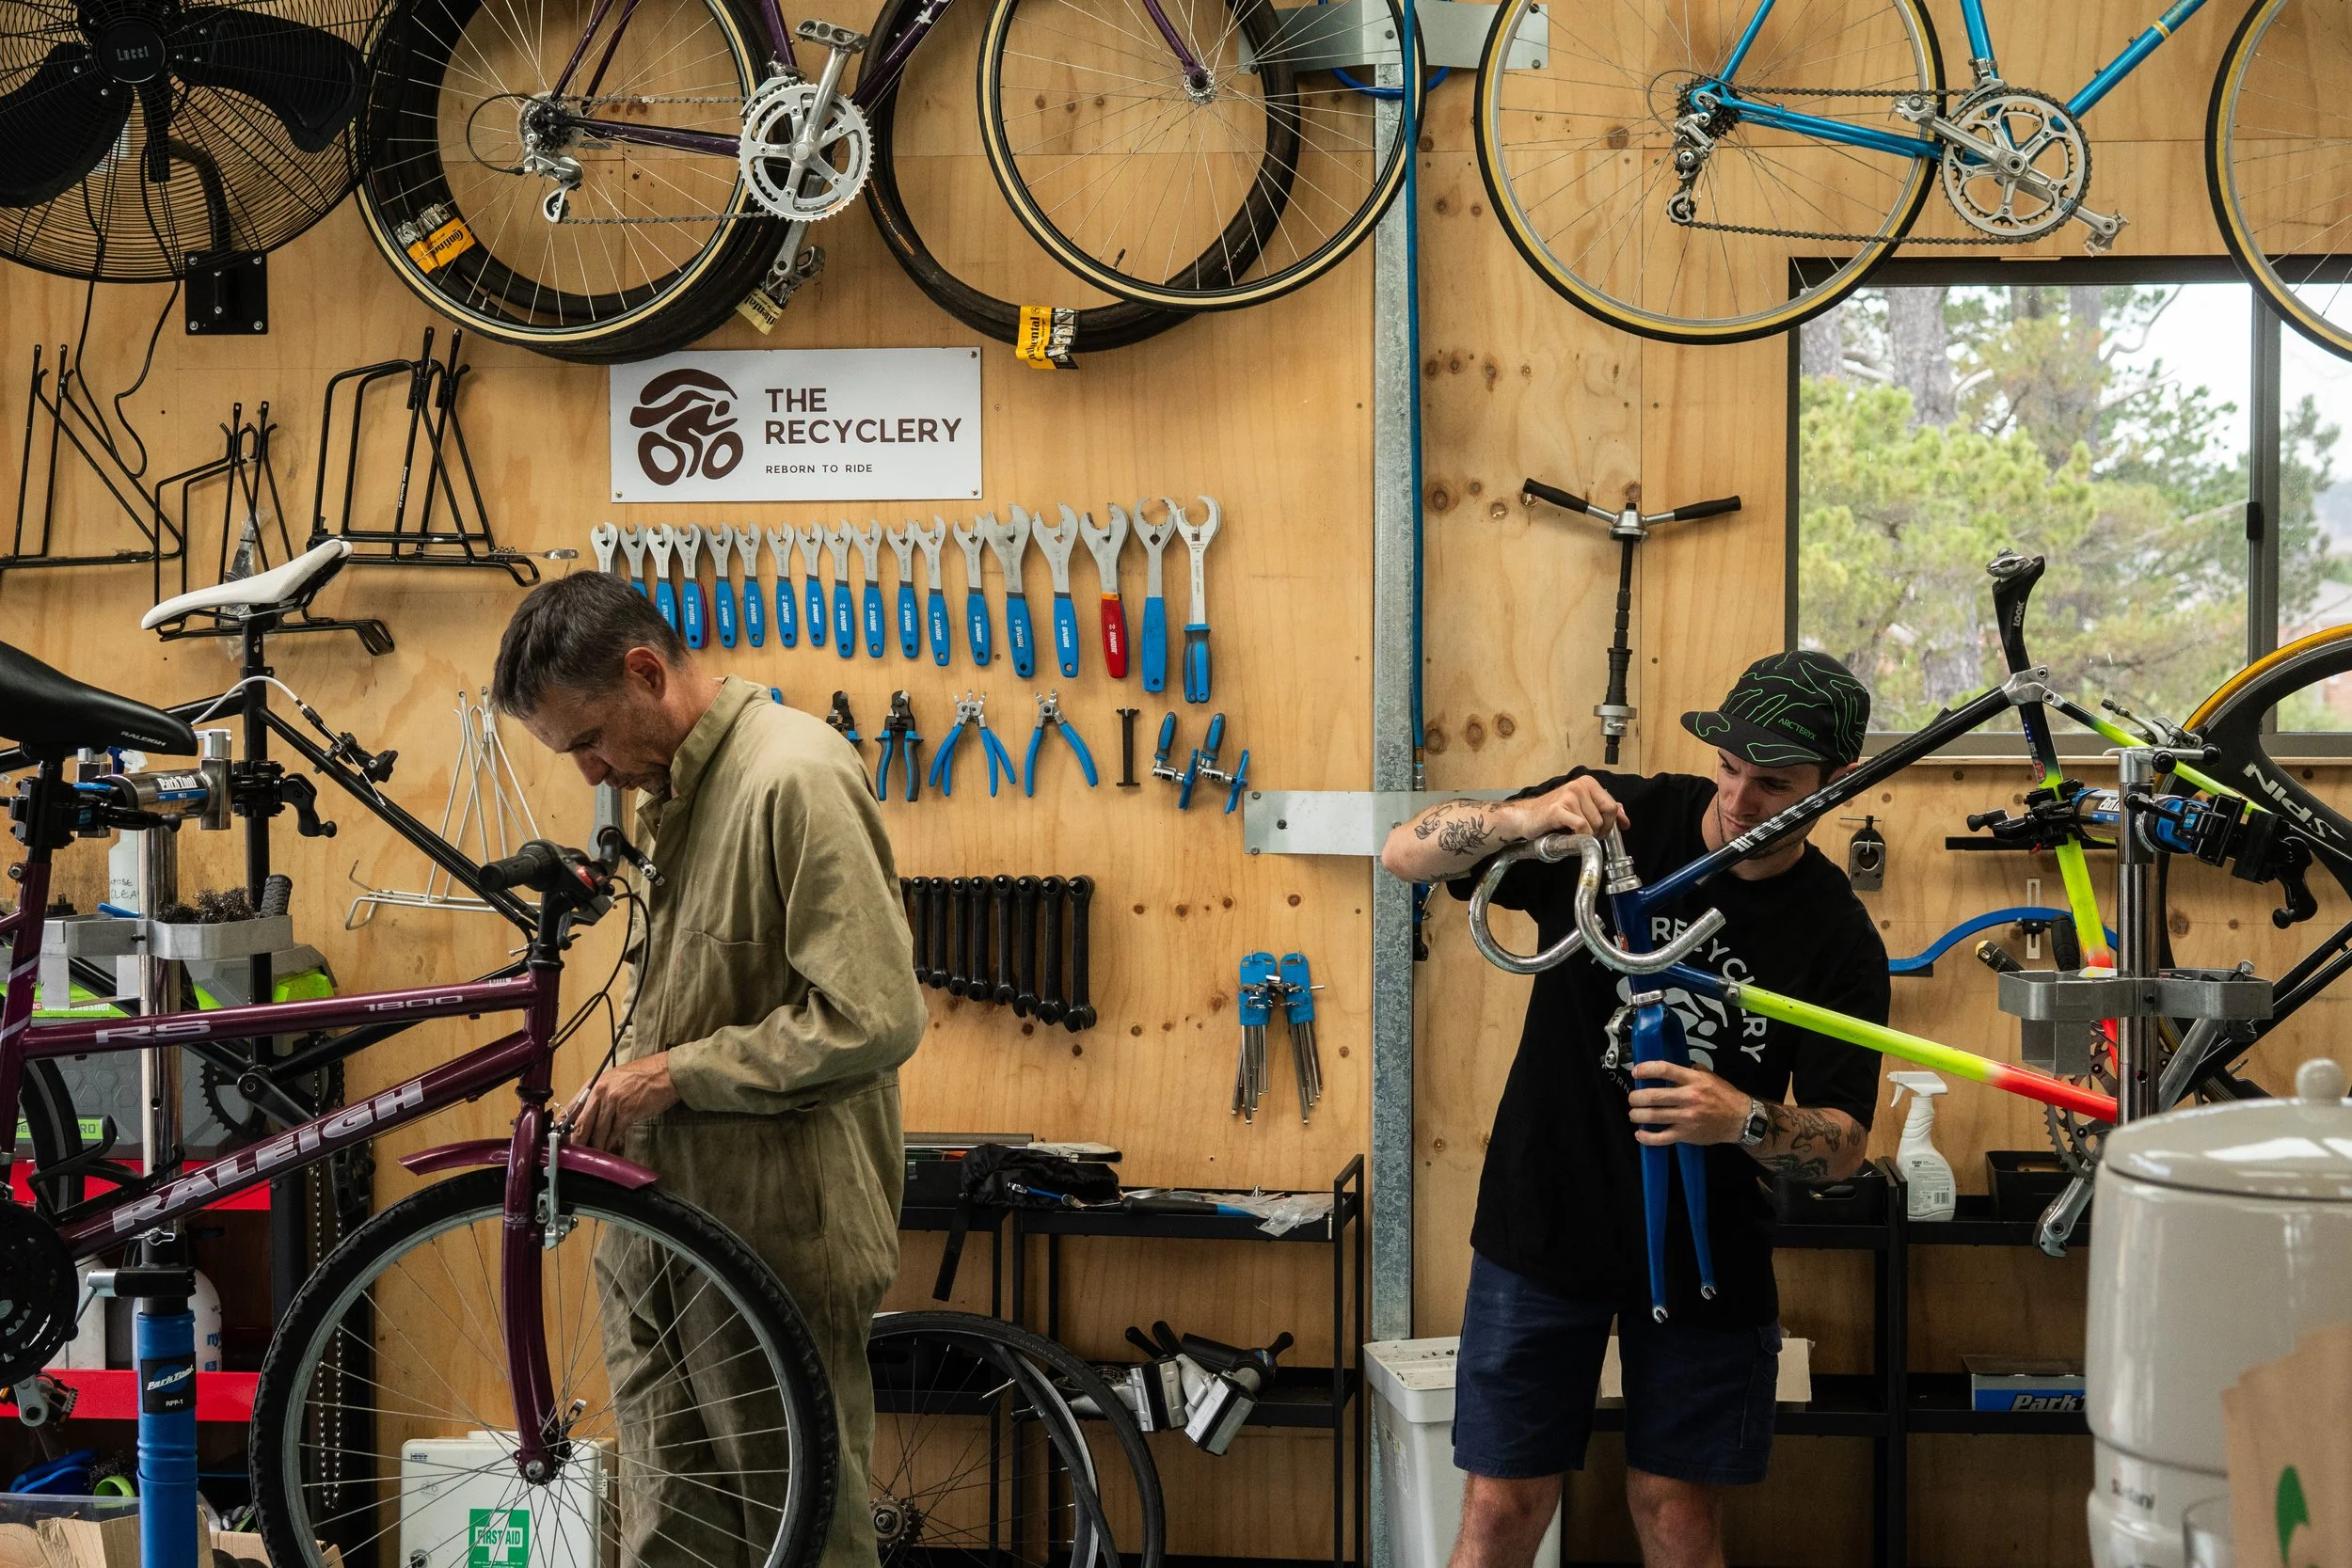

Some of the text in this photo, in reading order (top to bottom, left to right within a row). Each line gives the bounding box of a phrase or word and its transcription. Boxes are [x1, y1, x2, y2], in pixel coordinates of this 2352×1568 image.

[765, 388, 827, 413] THE
[765, 418, 962, 445] RECYCLERY
[766, 464, 873, 474] REBORN TO RIDE
[2013, 599, 2025, 627] LOOK
[1015, 626, 1024, 648] UNIOR
[120, 730, 167, 746] RALEIGH
[364, 995, 463, 1012] 1800
[96, 1020, 211, 1044] RS
[112, 1081, 423, 1233] RALEIGH
[166, 1399, 184, 1408] RPP-1
[477, 1529, 521, 1545] FIRST AID
